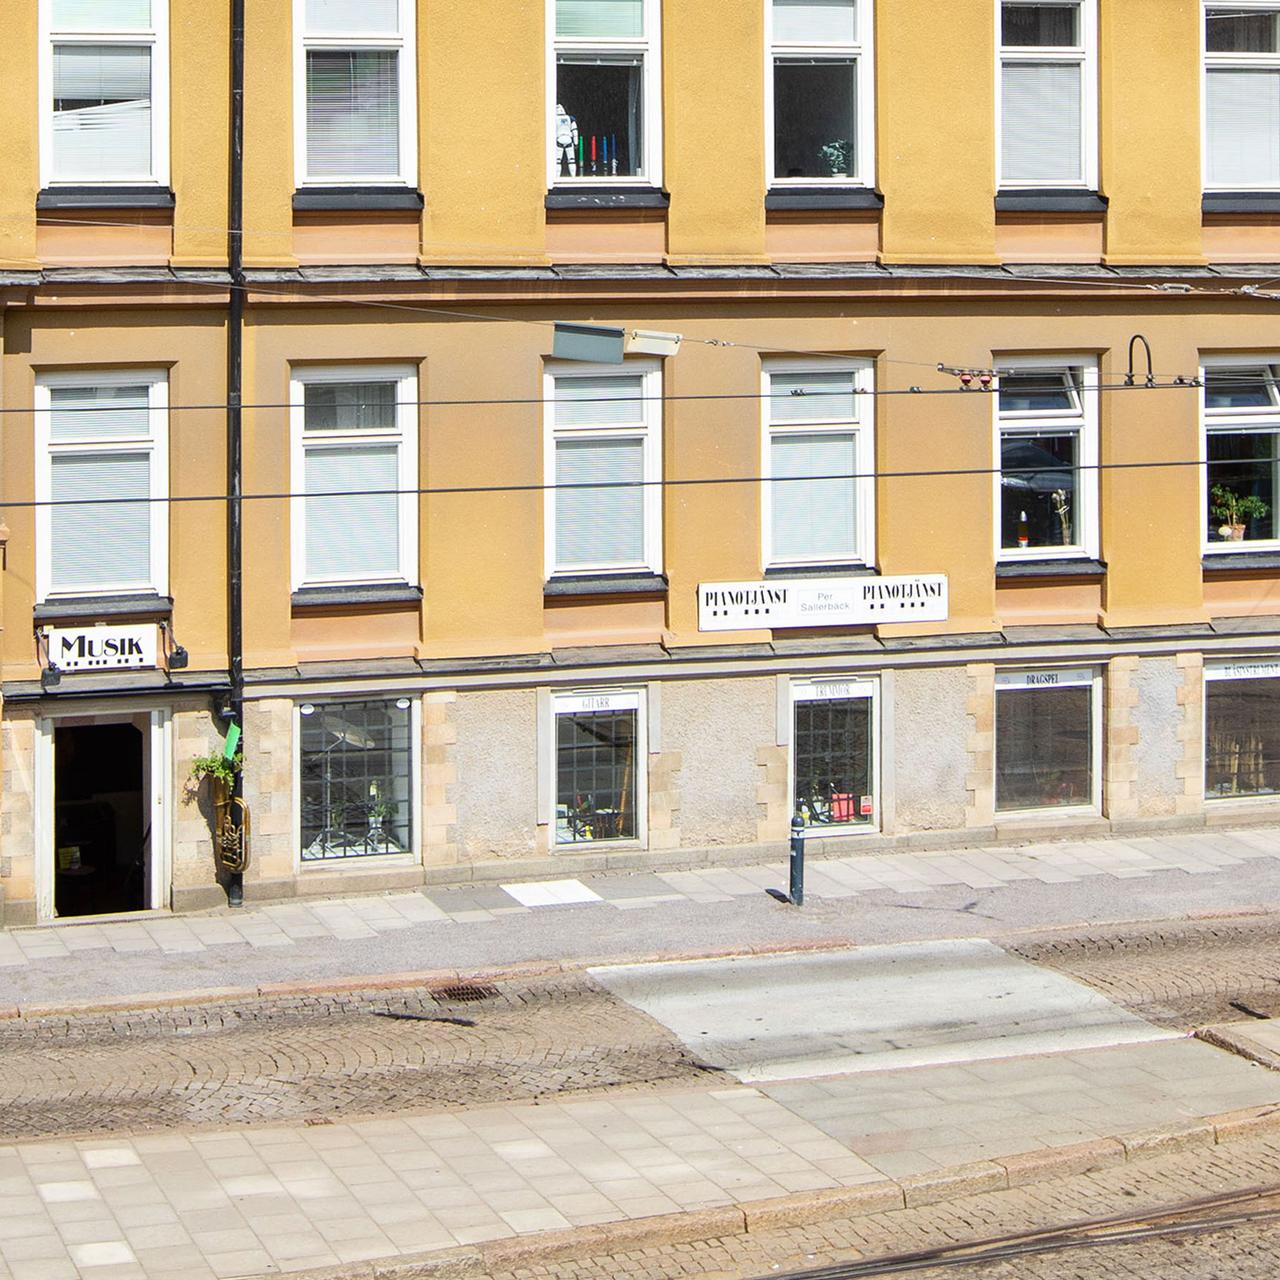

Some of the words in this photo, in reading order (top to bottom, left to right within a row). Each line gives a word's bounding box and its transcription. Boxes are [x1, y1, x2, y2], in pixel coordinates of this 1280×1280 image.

[705, 585, 789, 606] PIANOTJÄNST
[817, 592, 833, 601] Per
[863, 579, 943, 600] PIANOTJÄNST
